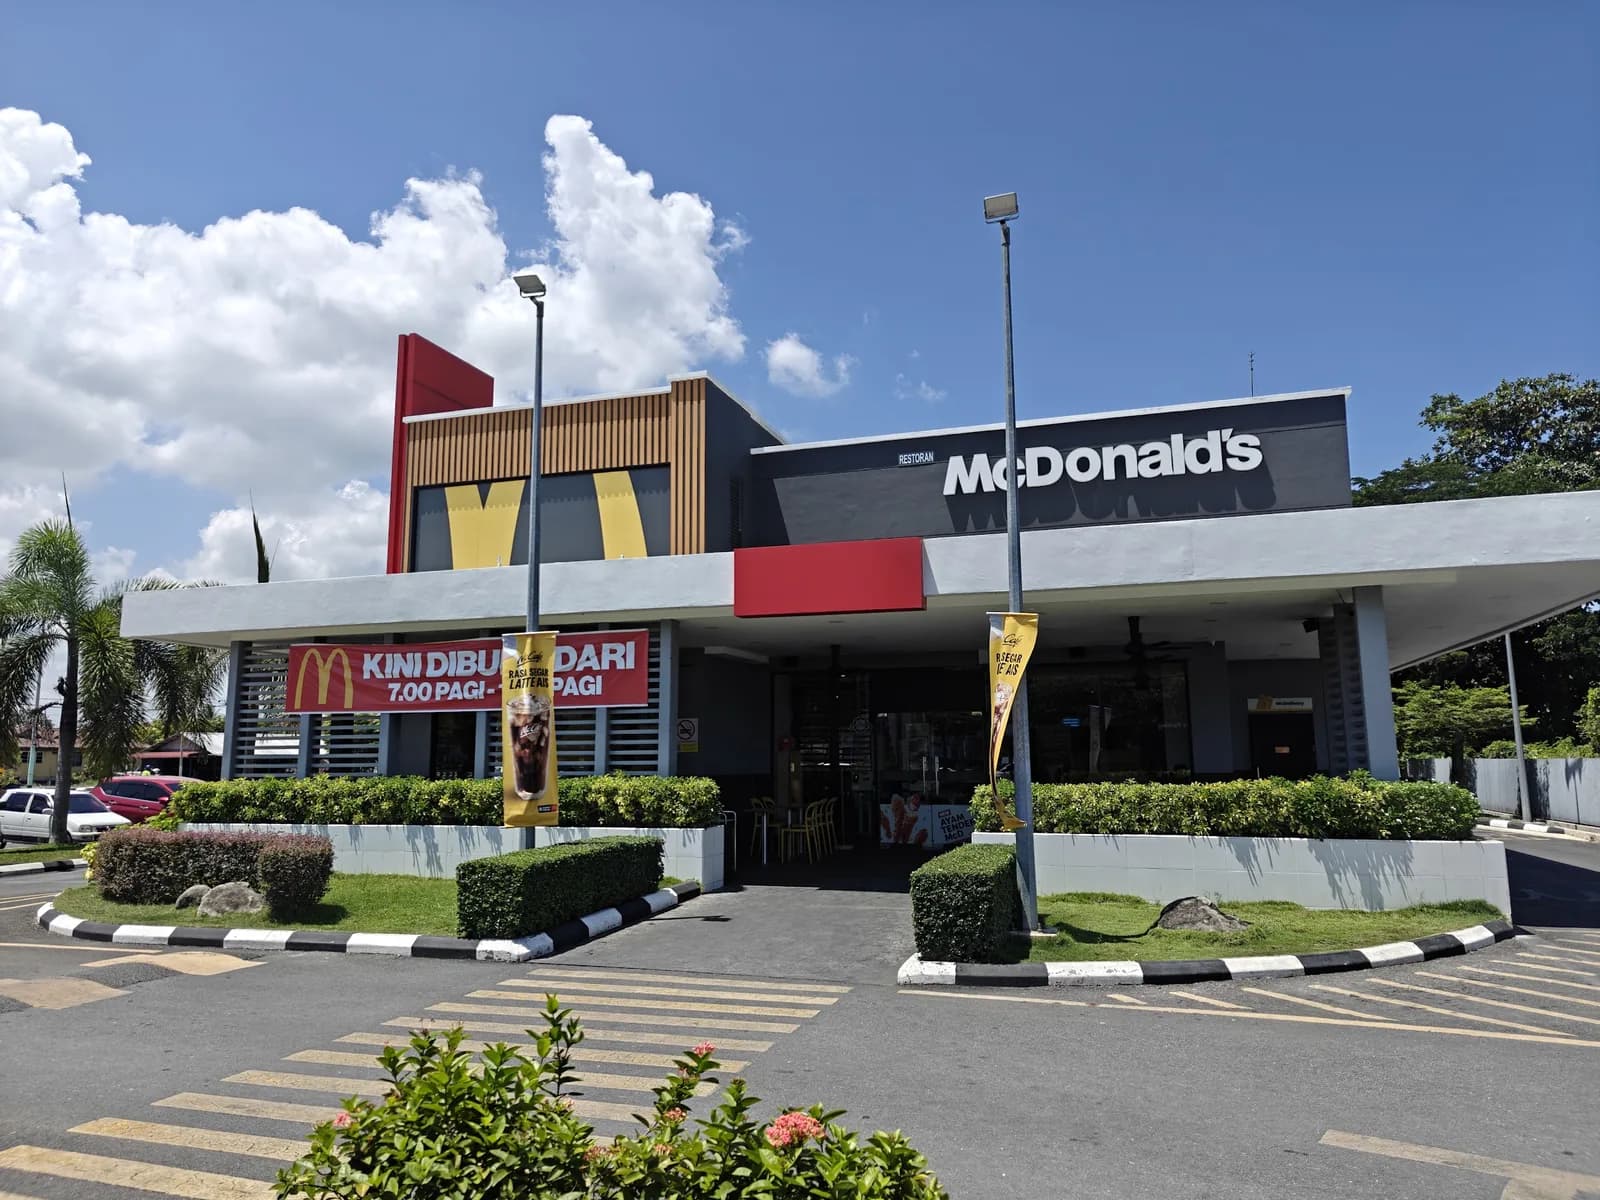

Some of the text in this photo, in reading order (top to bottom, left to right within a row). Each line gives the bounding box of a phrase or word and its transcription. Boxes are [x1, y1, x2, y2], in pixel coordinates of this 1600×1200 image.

[899, 452, 934, 465] RESTORAN
[943, 428, 1263, 496] McDonald's
[363, 641, 636, 679] KINI DIBU DARI
[388, 682, 432, 702] 7.00
[435, 680, 486, 700] PAGI
[553, 675, 602, 697] PAGI
